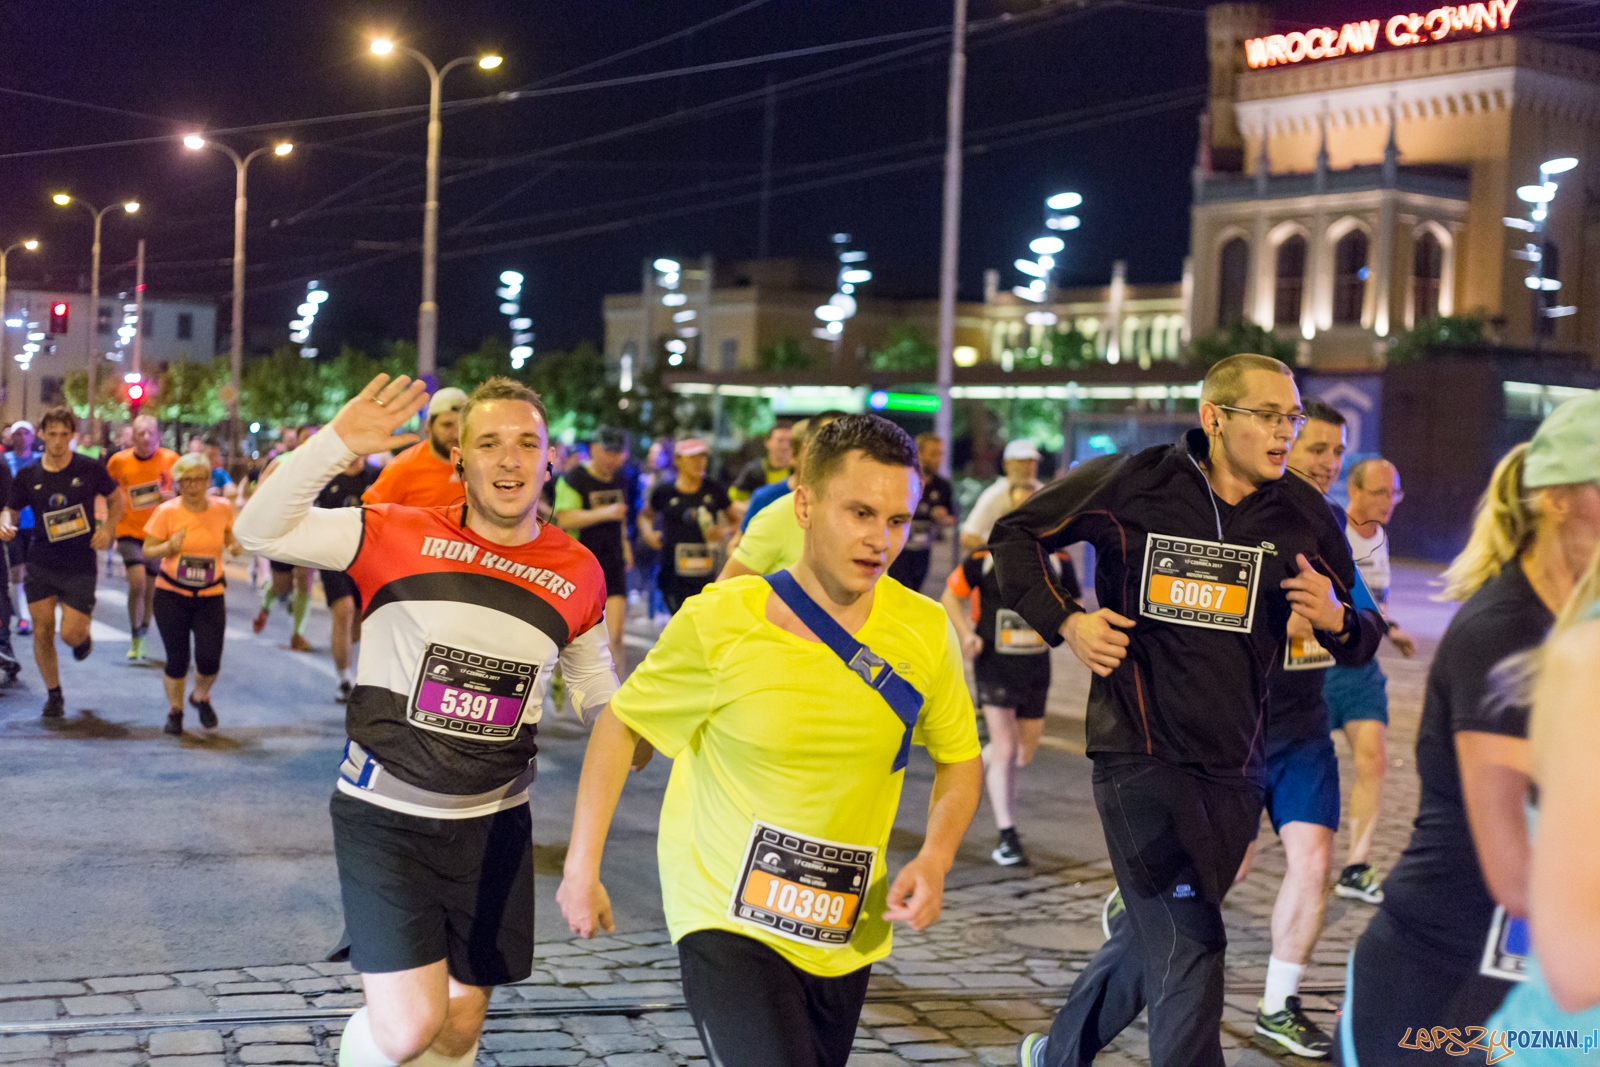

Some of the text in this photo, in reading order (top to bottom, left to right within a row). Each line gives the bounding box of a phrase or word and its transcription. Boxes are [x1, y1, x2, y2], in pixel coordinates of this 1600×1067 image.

[420, 536, 479, 563] IRON
[1170, 579, 1227, 610] 6067
[440, 688, 499, 722] 5391
[765, 879, 845, 925] 10399
